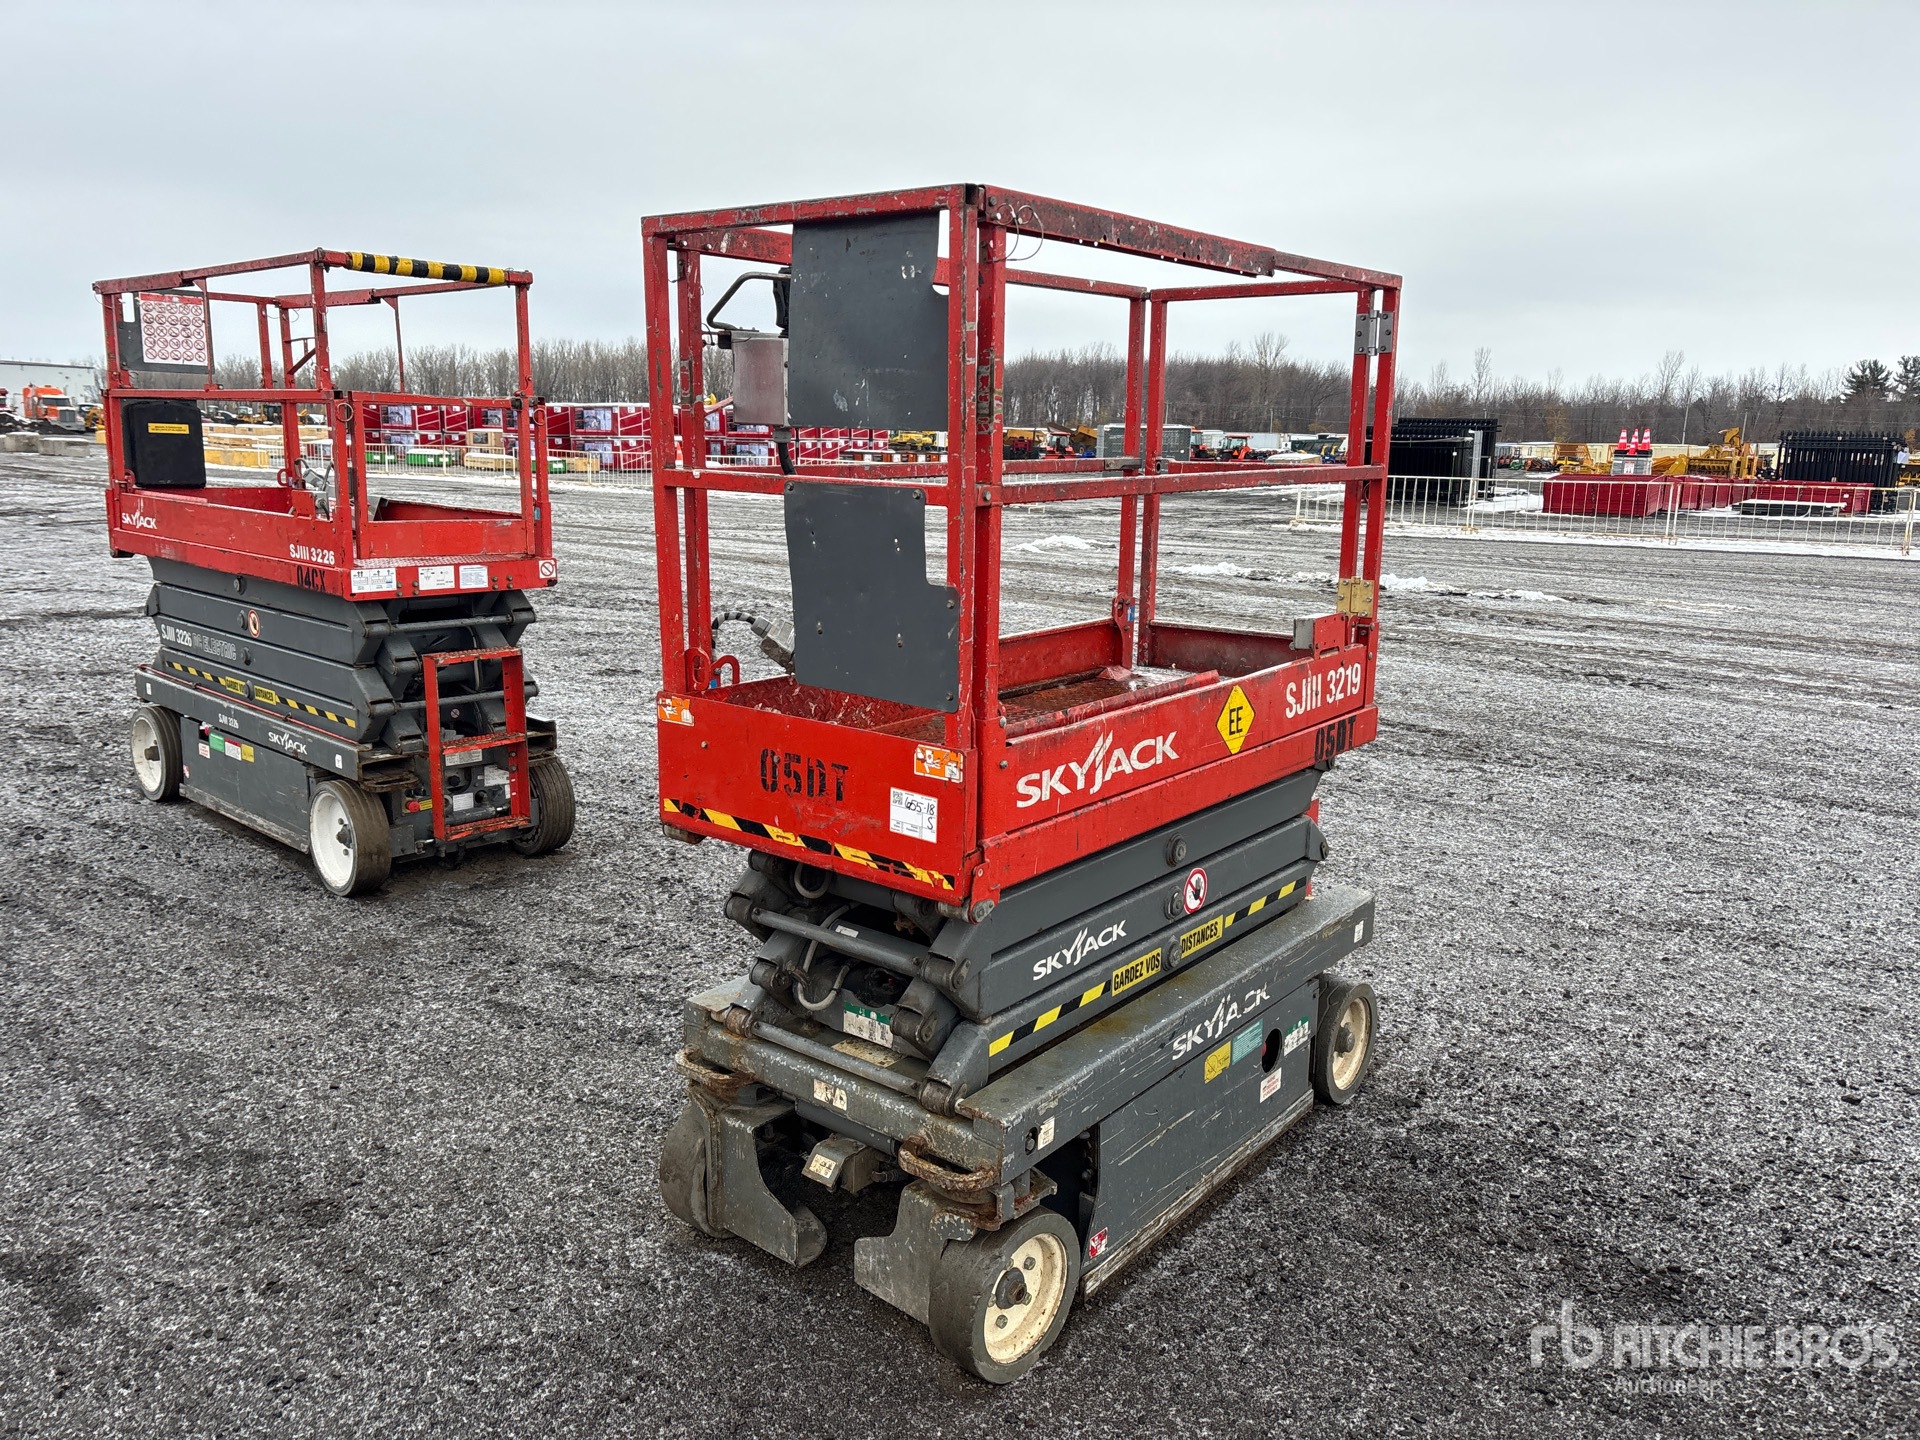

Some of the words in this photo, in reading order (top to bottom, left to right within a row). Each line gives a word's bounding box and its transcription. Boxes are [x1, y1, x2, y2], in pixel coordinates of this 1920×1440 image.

[289, 543, 310, 561] SJIII
[310, 547, 335, 565] 3226
[296, 565, 327, 592] 04CX
[176, 628, 193, 647] 3226
[1285, 672, 1322, 719] SJIII
[1326, 662, 1361, 704] 3219
[268, 731, 308, 755] SKYJACK
[1228, 705, 1243, 736] EE
[1314, 715, 1357, 761] 05DT
[761, 748, 849, 801] 05DT
[1016, 730, 1180, 808] SKYJACK
[1033, 919, 1127, 981] SKYJACK
[1113, 958, 1144, 991] GARDEZ
[1145, 952, 1161, 974] VOS
[1180, 921, 1219, 954] DISTANCES
[1172, 982, 1271, 1060] SKYJACK
